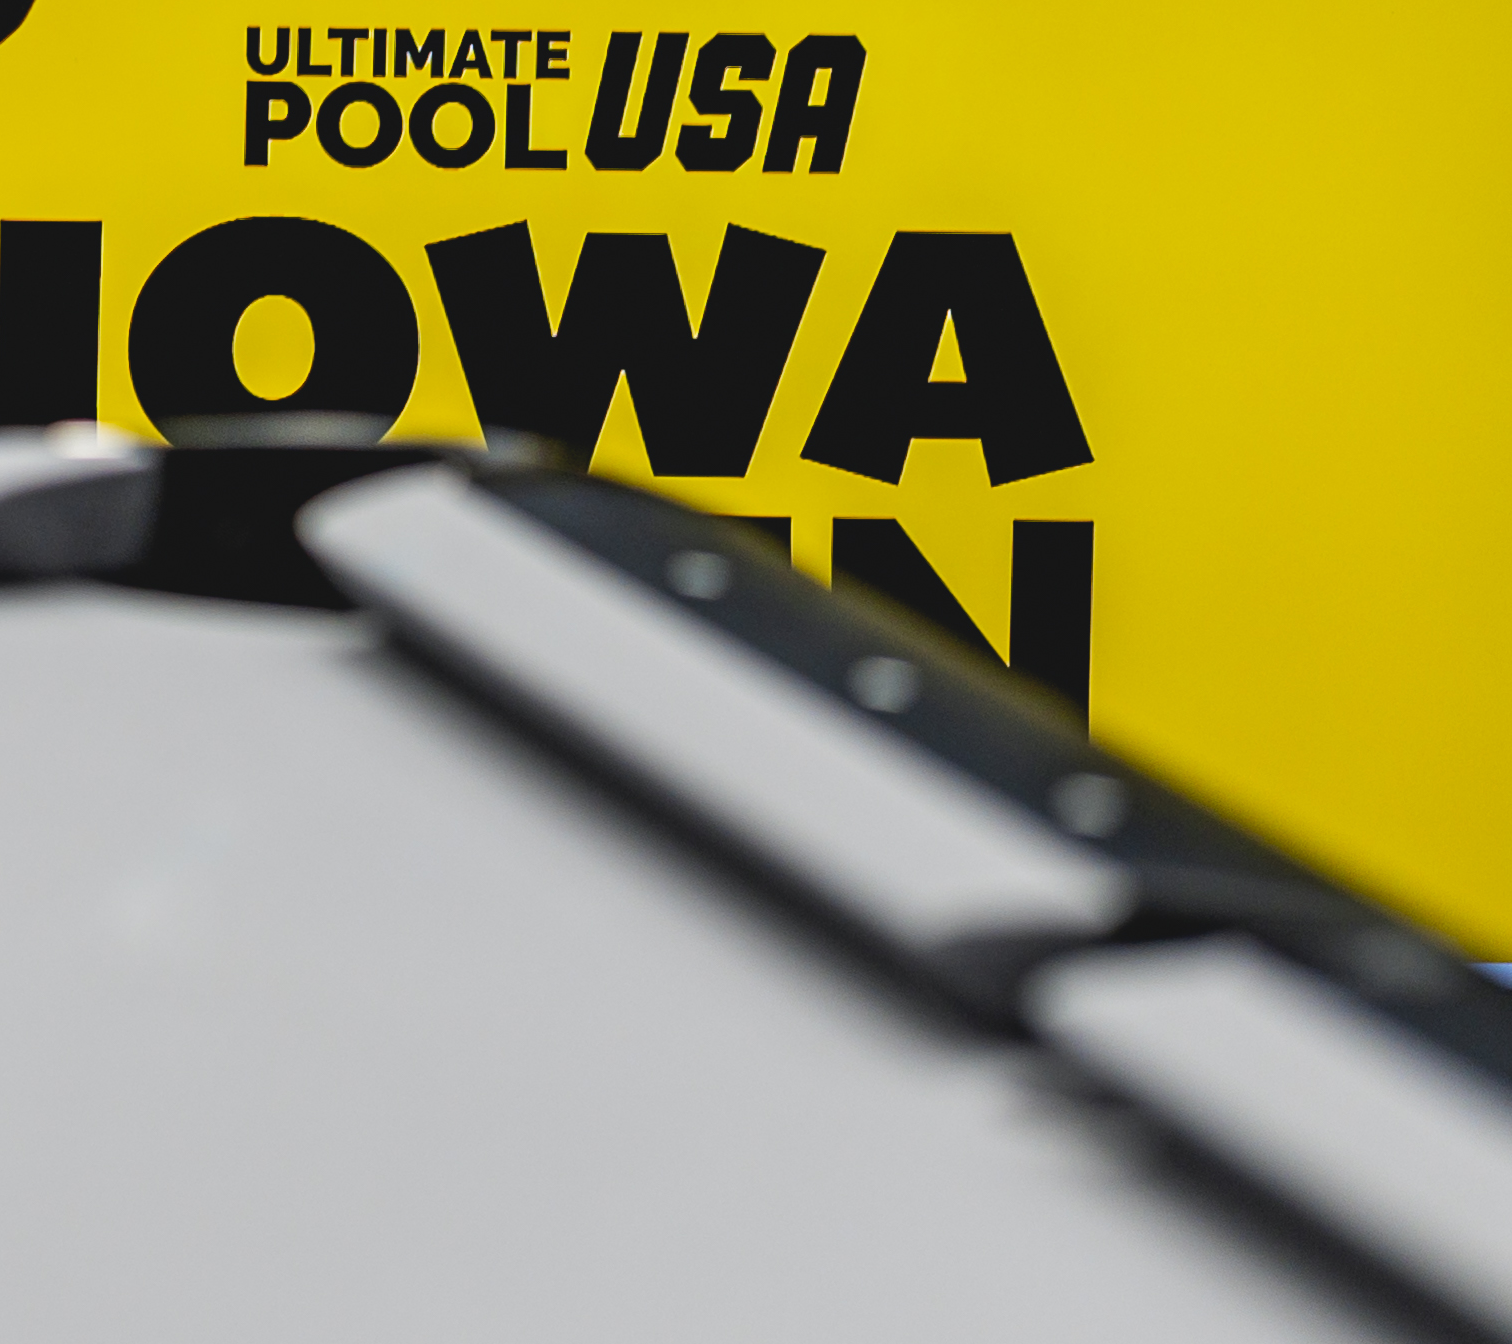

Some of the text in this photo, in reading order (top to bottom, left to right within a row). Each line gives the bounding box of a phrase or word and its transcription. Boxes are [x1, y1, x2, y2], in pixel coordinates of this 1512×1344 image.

[246, 25, 572, 79] ULTIMATE
[244, 31, 868, 174] POOL USA
